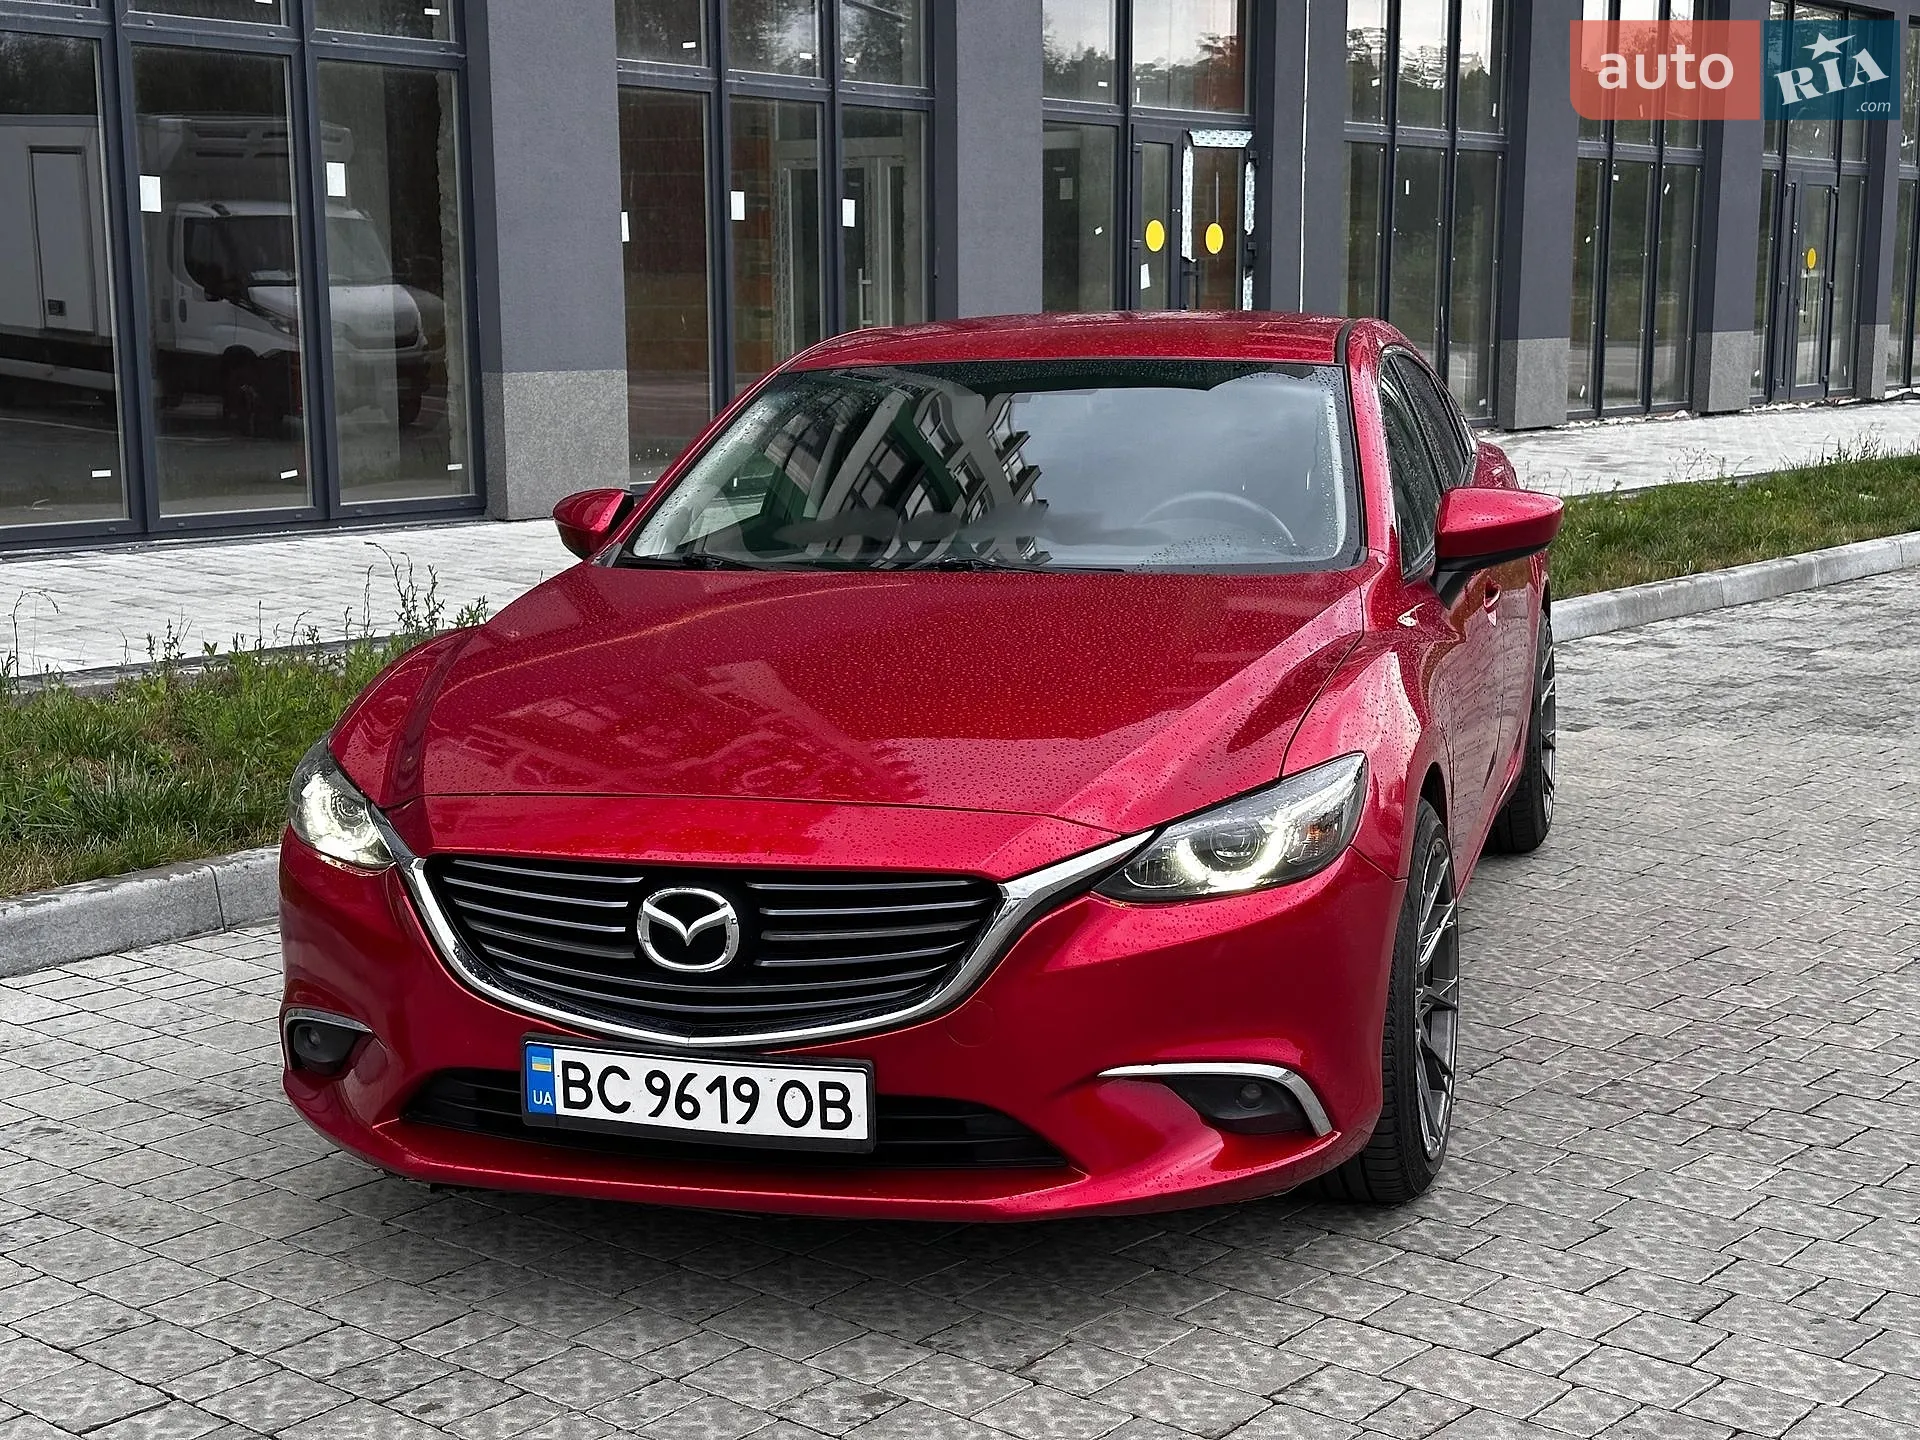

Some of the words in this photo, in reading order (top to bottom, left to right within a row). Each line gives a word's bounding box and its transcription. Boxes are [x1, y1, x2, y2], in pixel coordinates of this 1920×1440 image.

[533, 1089, 553, 1106] UA
[561, 1060, 631, 1114] BC
[644, 1069, 760, 1125] 9619
[776, 1079, 853, 1131] OB
